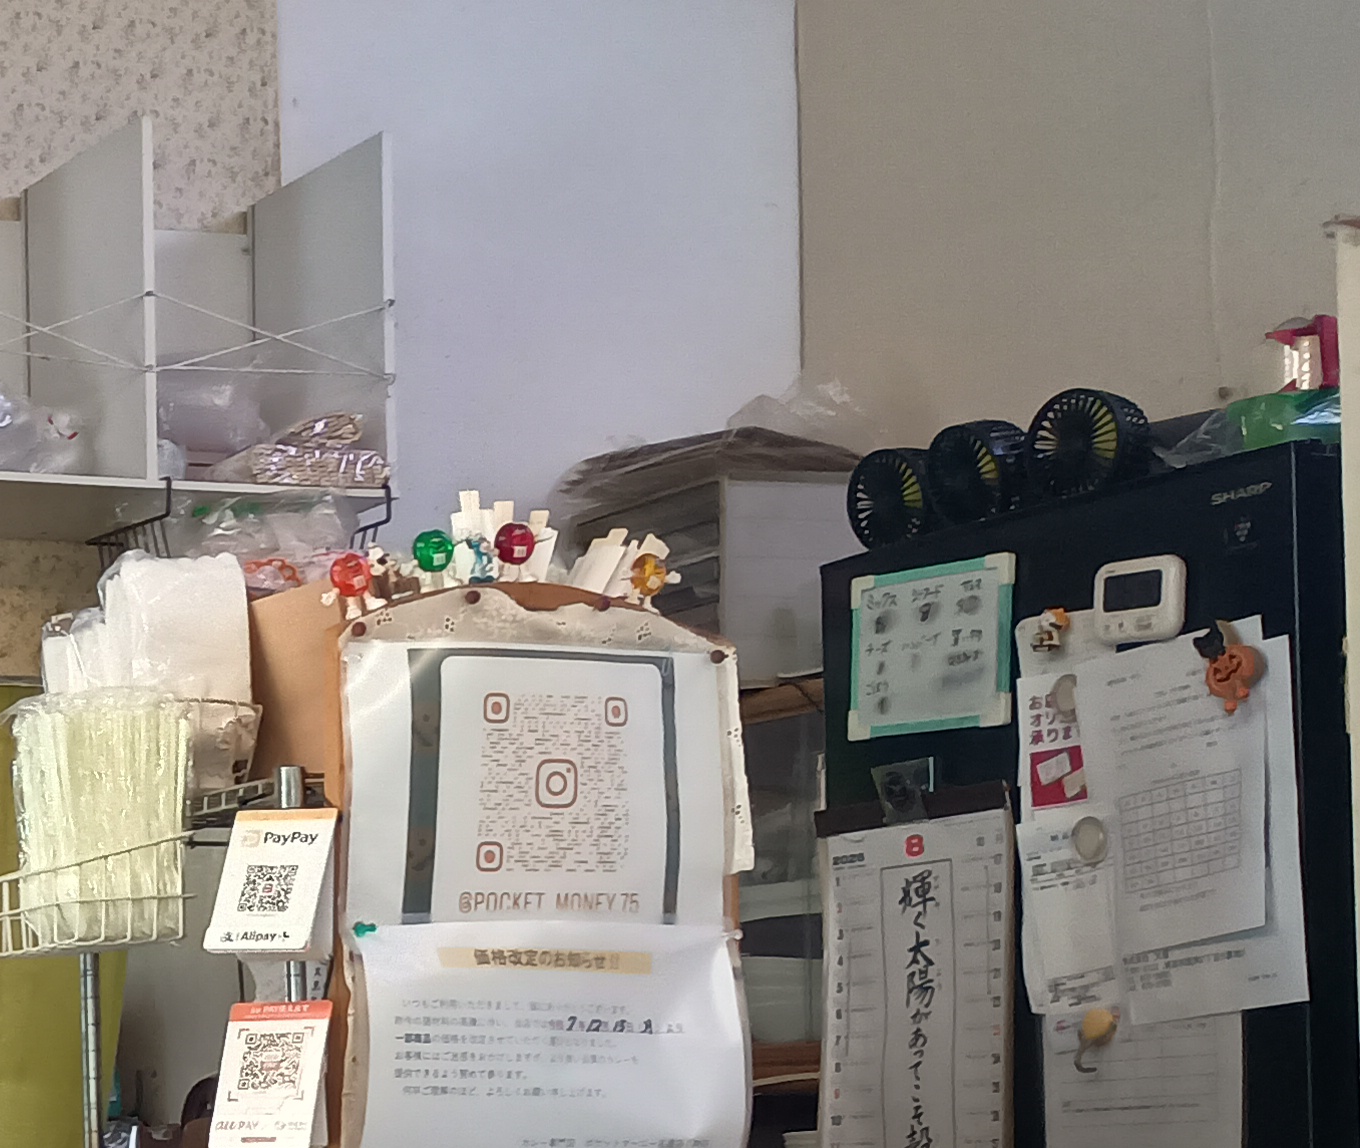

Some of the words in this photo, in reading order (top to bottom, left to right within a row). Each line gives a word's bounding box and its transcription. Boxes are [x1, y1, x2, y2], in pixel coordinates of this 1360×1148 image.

[1210, 482, 1273, 506] SHARP
[263, 831, 319, 846] PayPay
[904, 833, 925, 858] 8
